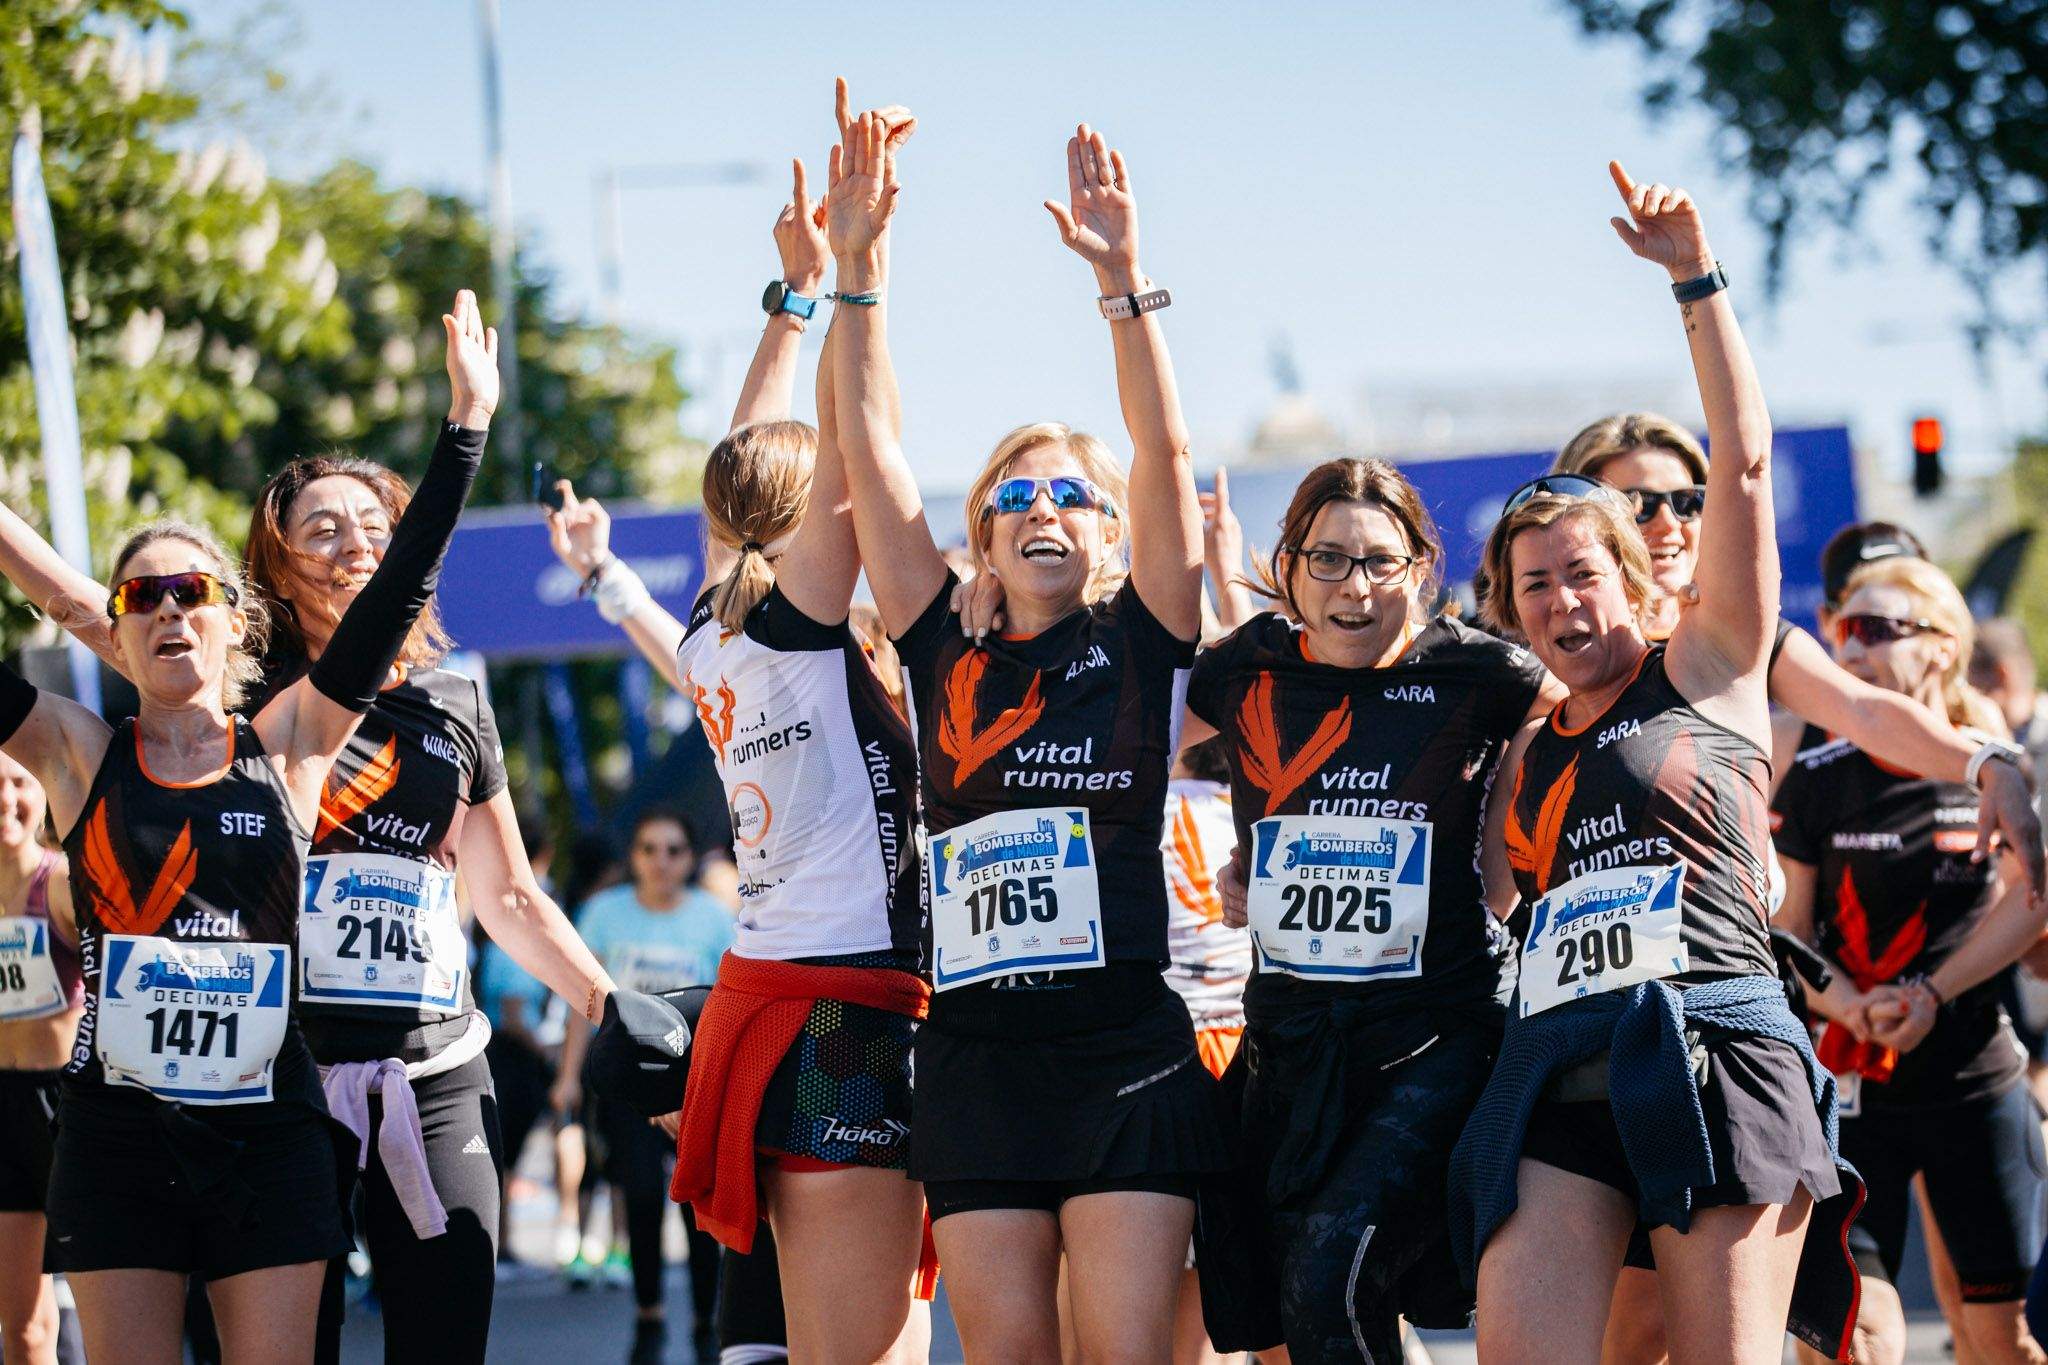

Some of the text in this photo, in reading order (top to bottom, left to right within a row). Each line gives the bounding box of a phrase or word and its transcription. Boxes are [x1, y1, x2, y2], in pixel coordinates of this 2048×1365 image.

[1384, 686, 1435, 702] SARA
[733, 720, 812, 766] runners
[1596, 718, 1642, 749] SARA
[1015, 737, 1093, 764] vital
[865, 740, 896, 797] vital
[1003, 766, 1133, 791] runners
[1321, 763, 1392, 790] vital
[1308, 798, 1428, 821] runners
[220, 812, 266, 837] STEF
[366, 813, 431, 846] vital
[1567, 803, 1627, 850] vital
[974, 832, 1054, 855] BOMBEROS
[1310, 840, 1393, 855] BOMBEROS
[971, 857, 1055, 885] DECIMAS
[1568, 836, 1672, 880] runners
[1300, 867, 1389, 882] DECIMAS
[351, 899, 427, 922] DECIMAS
[965, 875, 1058, 936] 1765
[1278, 884, 1392, 934] 2025
[1572, 885, 1648, 910] BOMBEROS
[174, 909, 240, 937] vital
[1560, 904, 1642, 936] DECIMAS
[1556, 922, 1633, 986] 290
[155, 989, 248, 1007] DECIMAS
[146, 1007, 239, 1058] 1471
